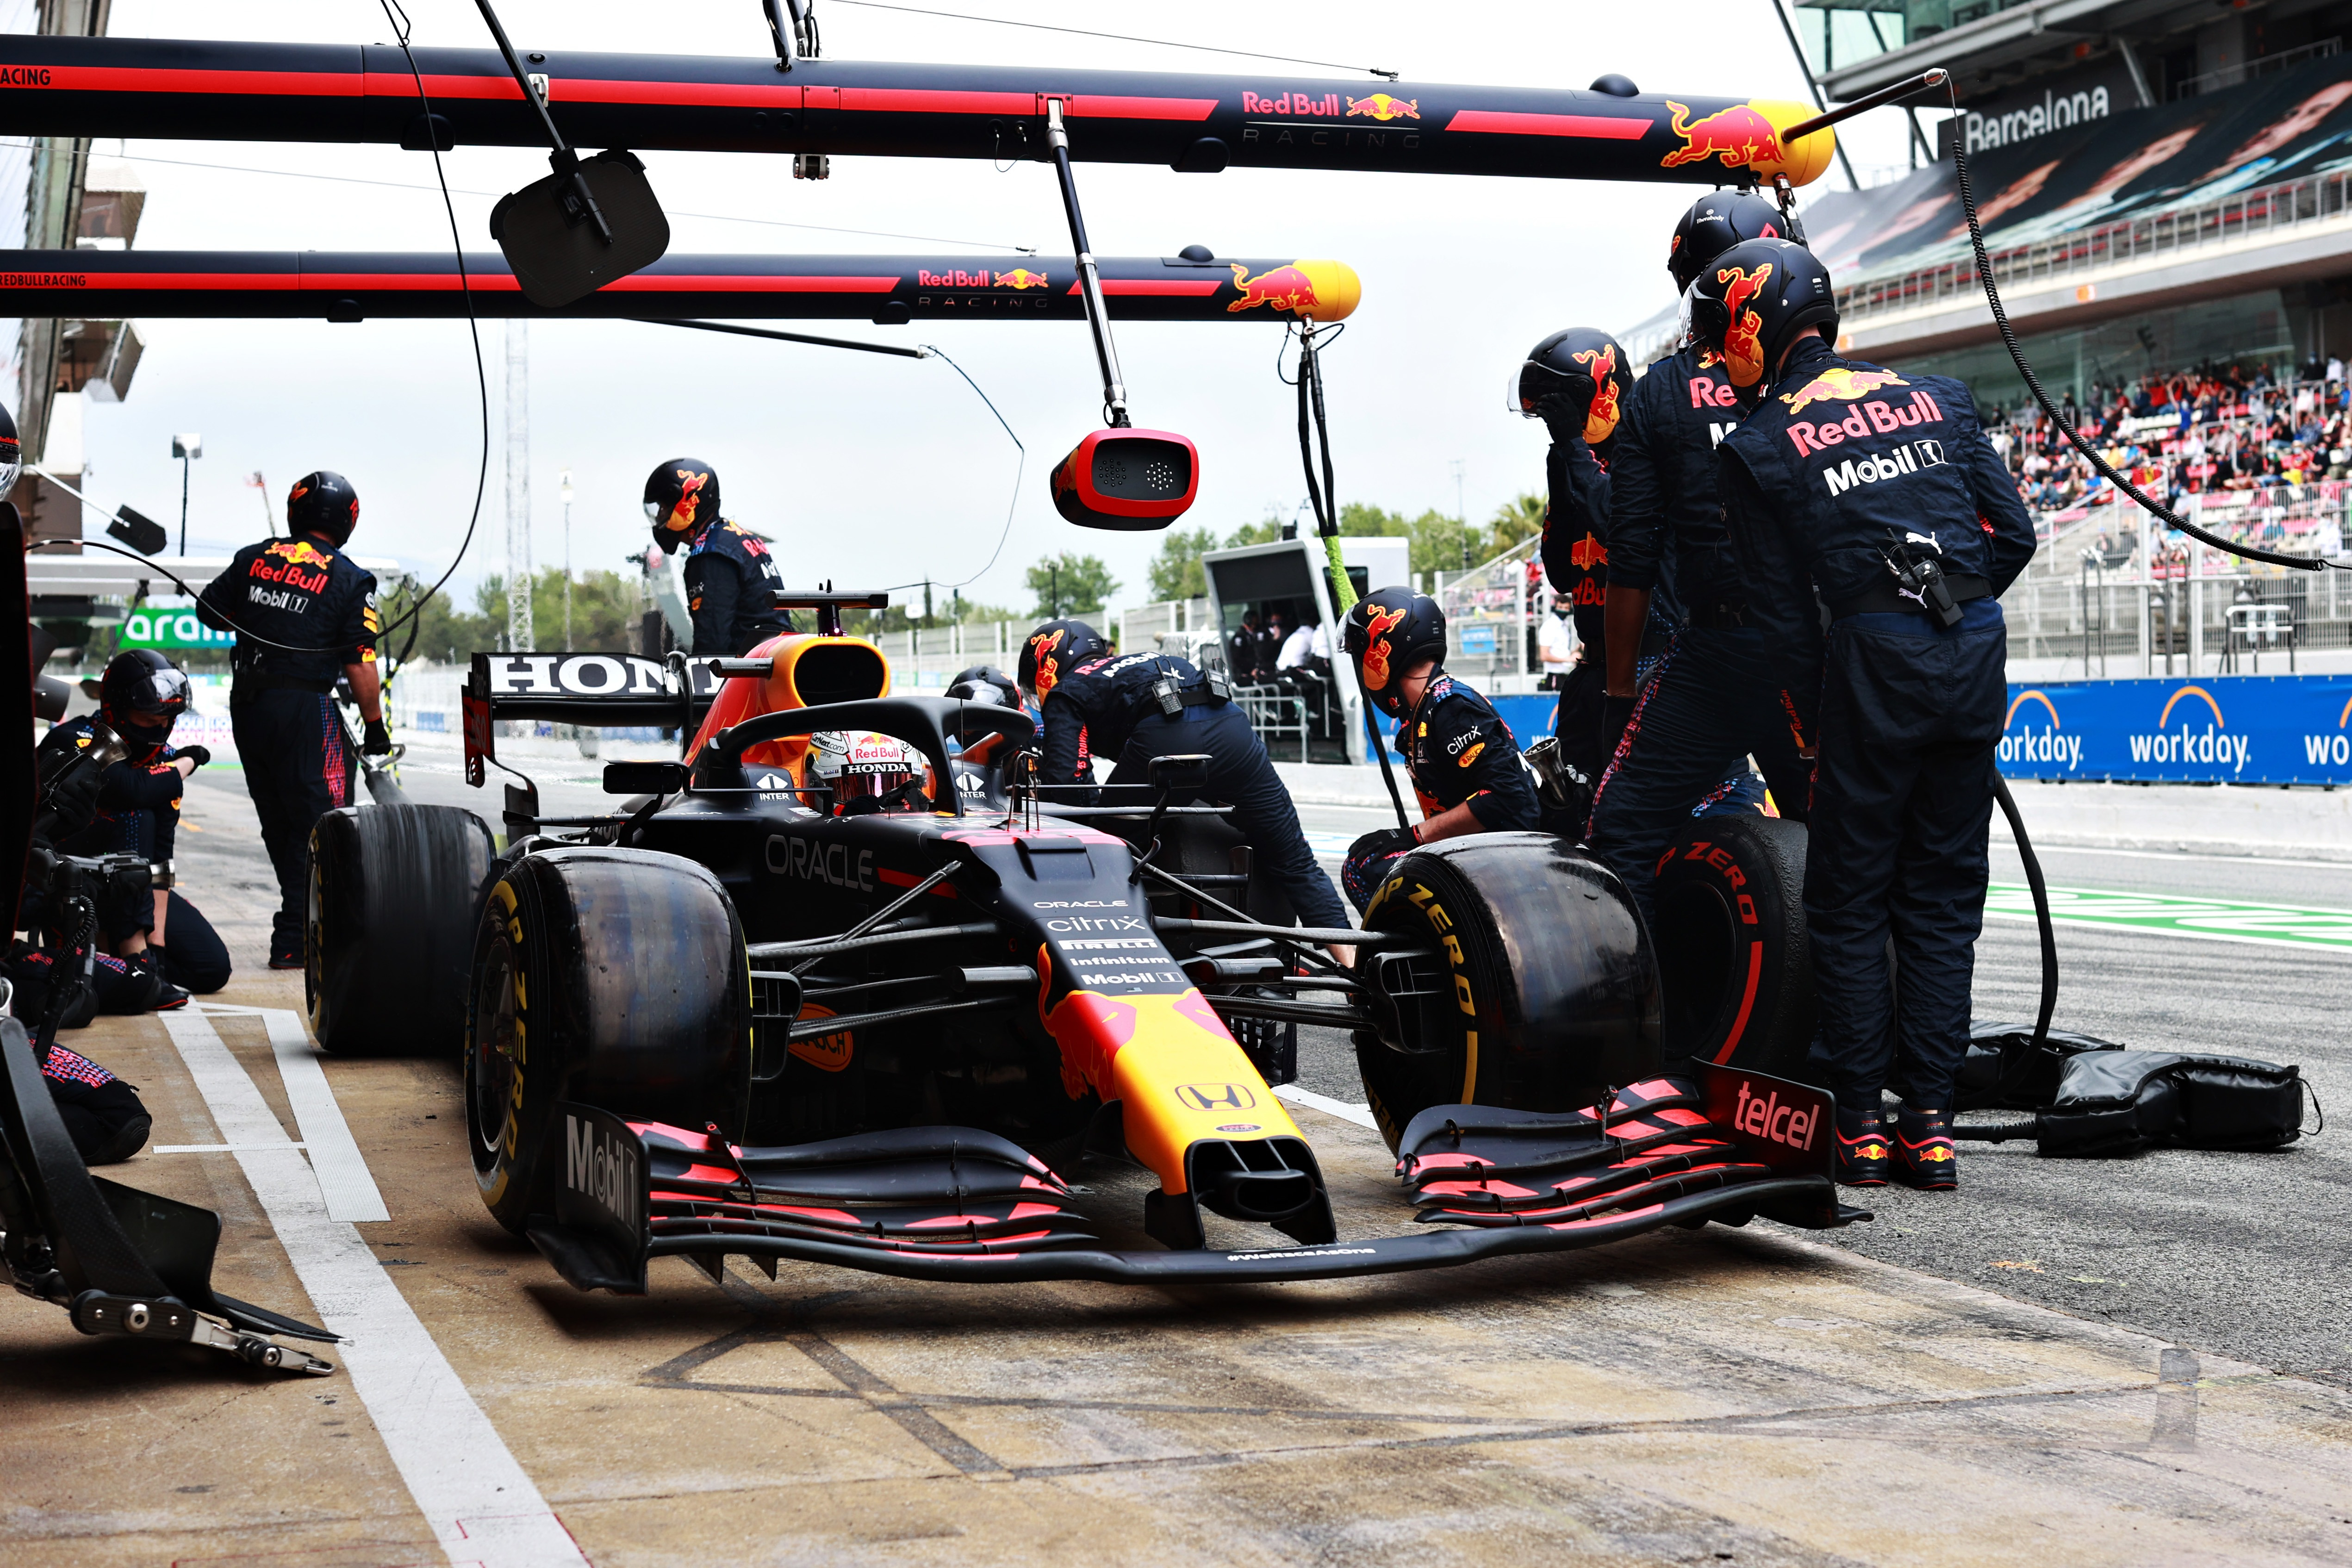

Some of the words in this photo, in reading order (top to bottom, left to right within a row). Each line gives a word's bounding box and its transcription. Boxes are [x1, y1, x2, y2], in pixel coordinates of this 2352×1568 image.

[1243, 92, 1290, 114] Red
[1293, 93, 1339, 116] Bull
[1965, 85, 2109, 155] Barcelona
[1243, 129, 1420, 148] RACING
[1697, 215, 1724, 224] Therabody
[918, 270, 953, 286] Red
[956, 270, 989, 286] Bull
[918, 298, 1048, 307] RACING
[1689, 377, 1737, 409] Re
[1787, 404, 1871, 458] Red
[1864, 391, 1942, 433] Bull
[1823, 445, 1918, 497] Mobil
[249, 558, 286, 582] Red
[285, 567, 329, 594] Bull
[248, 585, 290, 609] Mobil
[126, 615, 233, 642] ara
[489, 656, 736, 694] HON
[1102, 652, 1159, 678] Mobil
[812, 733, 844, 752] CarNext.com
[1447, 726, 1481, 754] citrix
[820, 750, 832, 759] citrix
[856, 747, 878, 759] Red
[880, 747, 899, 758] Bull
[1467, 747, 1482, 763] RAUC
[847, 764, 909, 774] HONDA
[765, 834, 874, 892] ORACLE
[1684, 842, 1758, 924] ZERO
[508, 916, 523, 944] P
[1047, 915, 1145, 932] citrix
[1058, 938, 1157, 950] PIRELLI
[1383, 876, 1403, 902] P
[1408, 883, 1476, 1016] ZERO
[1070, 956, 1170, 966] infinitum
[1081, 972, 1156, 985] Mobil
[505, 971, 528, 1161] ZERO
[1734, 1081, 1820, 1151] telcel
[566, 1114, 624, 1223] Mobil
[1227, 1248, 1376, 1261] #WeRaceAsOne
